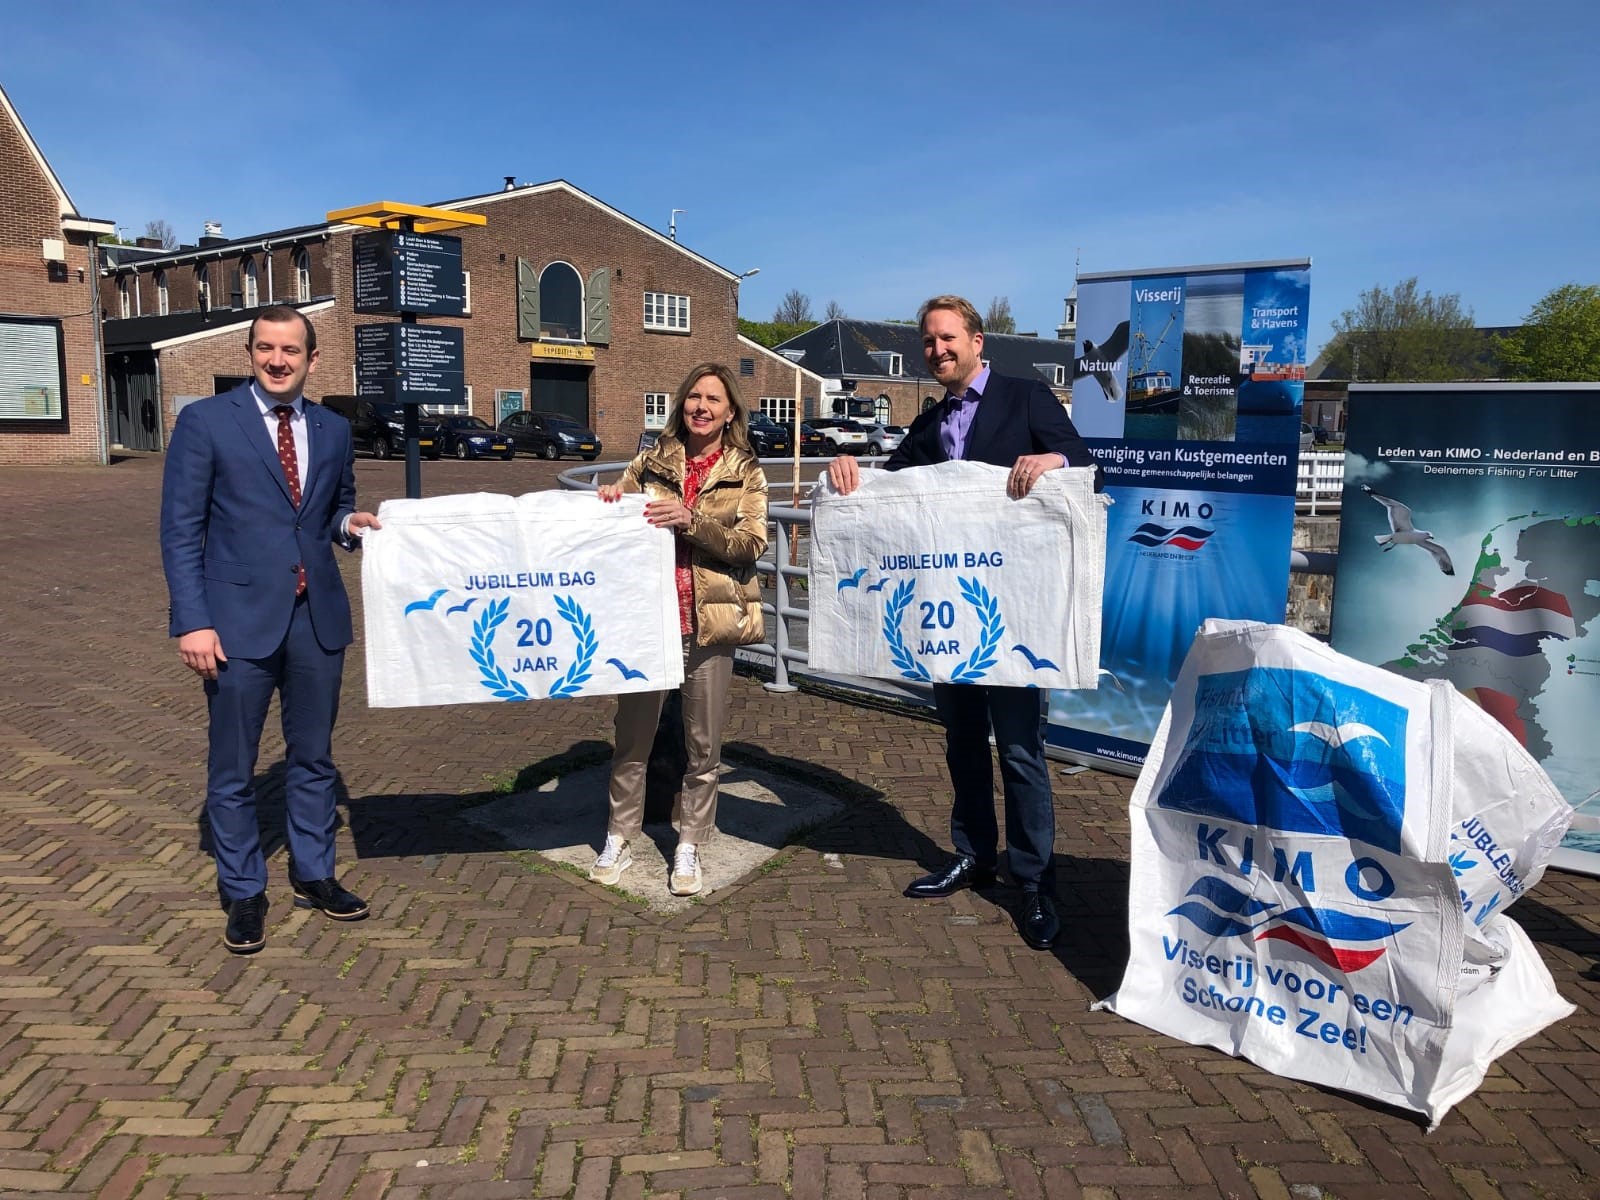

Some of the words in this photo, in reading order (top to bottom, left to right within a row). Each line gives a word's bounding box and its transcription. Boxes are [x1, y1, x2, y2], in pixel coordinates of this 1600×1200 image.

[1135, 287, 1181, 304] Visserij
[1252, 306, 1298, 317] Transport
[1251, 319, 1260, 329] &
[1262, 319, 1298, 329] Havens
[1080, 359, 1122, 372] Natuur
[1188, 374, 1231, 385] Recreatie
[1183, 385, 1192, 395] &
[1194, 386, 1235, 396] Toerisme
[1088, 446, 1145, 464] reniging
[1148, 450, 1171, 461] van
[1175, 448, 1287, 467] Kustgemeenten
[1378, 446, 1415, 457] Leden
[1419, 449, 1441, 458] van
[1445, 447, 1482, 459] KIMO
[1493, 448, 1564, 461] Nederland
[1568, 452, 1585, 461] en
[1590, 450, 1600, 462] B
[1103, 466, 1123, 475] KIMO
[1141, 468, 1216, 481] gemeenschappelijke
[1217, 471, 1254, 483] belangen
[1423, 464, 1484, 476] Deelnemers
[1487, 466, 1526, 479] Fishing
[1529, 467, 1547, 478] For
[1550, 468, 1578, 478] Litter
[1141, 499, 1214, 520] KIMO
[879, 552, 958, 571] JUBILEUM
[964, 551, 1003, 567] BAG
[464, 572, 554, 590] JUBILEUM
[559, 571, 597, 586] BAG
[919, 600, 955, 630] 20
[515, 618, 552, 647] 20
[917, 639, 960, 655] JAAR
[512, 656, 558, 673] JAAR
[1197, 823, 1396, 902] KIMO
[1460, 966, 1480, 974] rdam
[1265, 965, 1344, 1004] voor
[1353, 993, 1415, 1026] een
[1182, 977, 1286, 1026] Schone
[1296, 1007, 1368, 1054] Zee!
